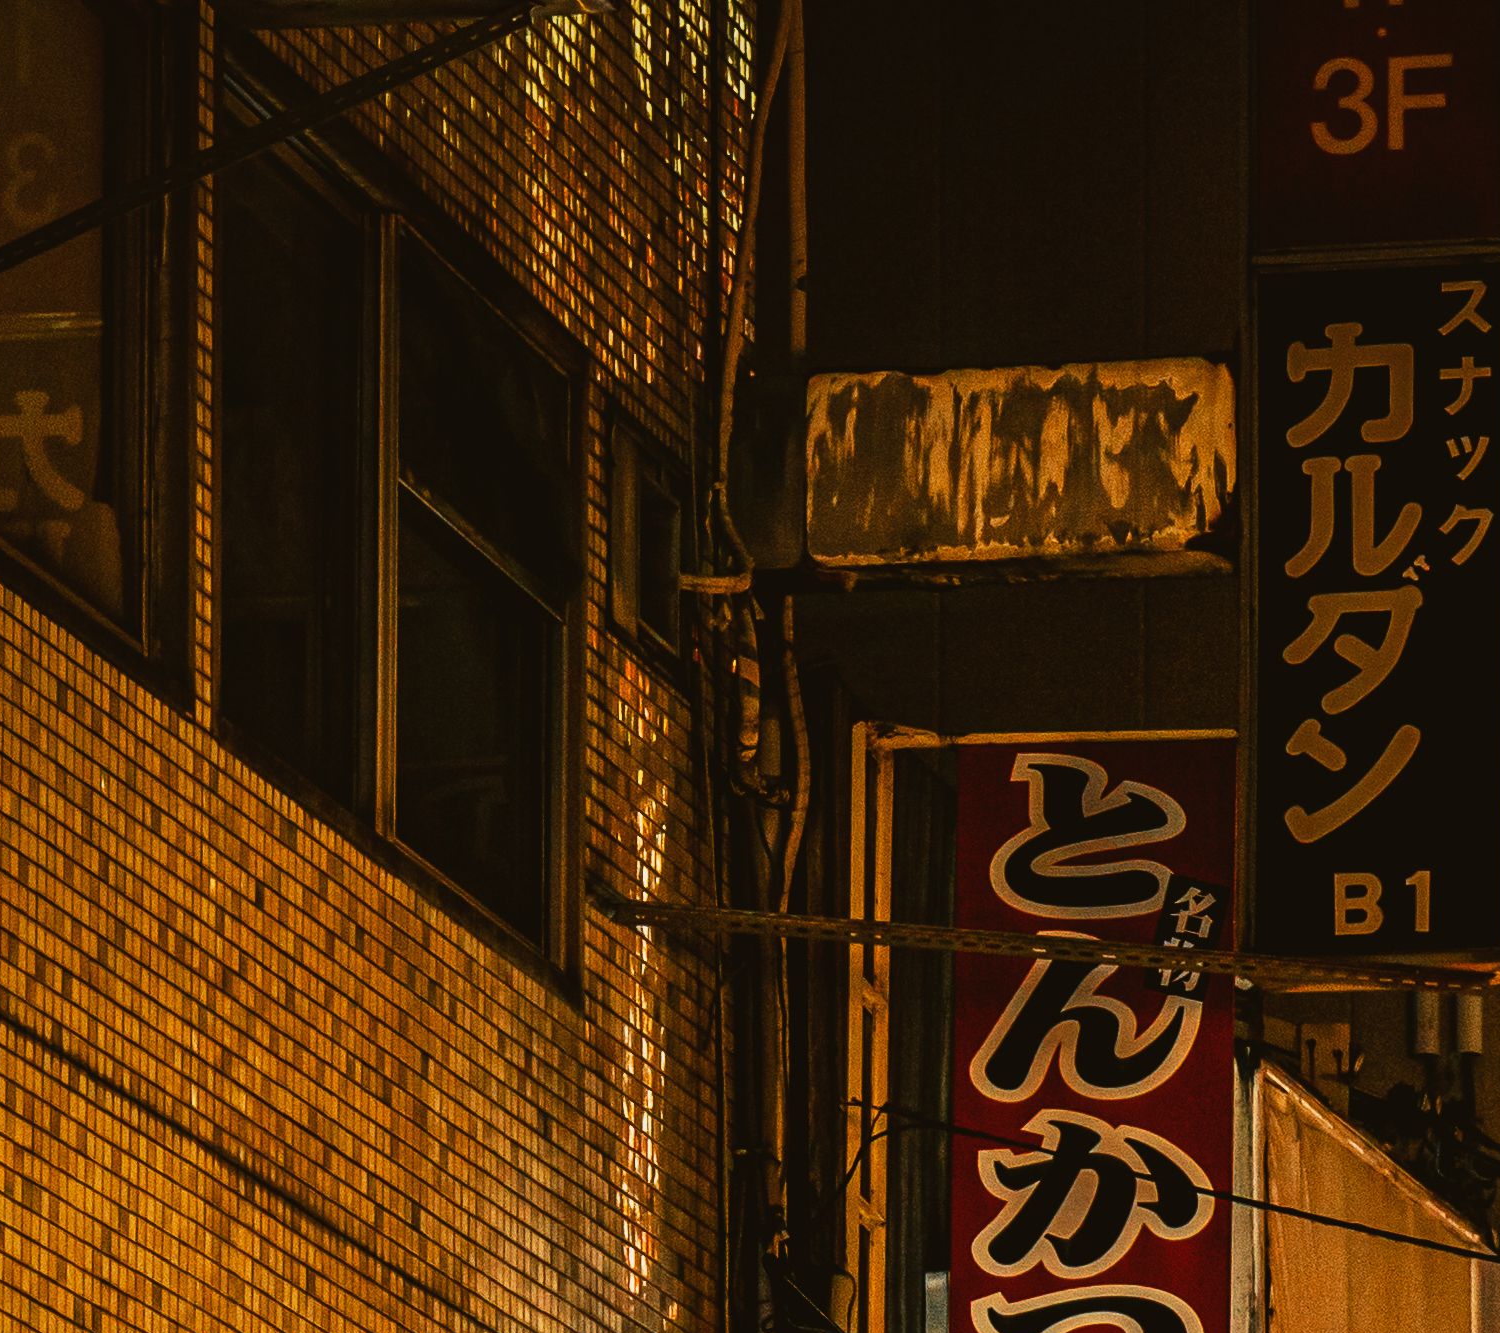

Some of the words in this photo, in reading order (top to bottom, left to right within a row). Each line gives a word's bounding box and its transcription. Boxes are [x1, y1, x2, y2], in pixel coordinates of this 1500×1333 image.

[1308, 52, 1455, 156] 3F
[1438, 279, 1496, 568] スナック
[1283, 321, 1425, 845] カルダン
[1333, 870, 1435, 938] B1
